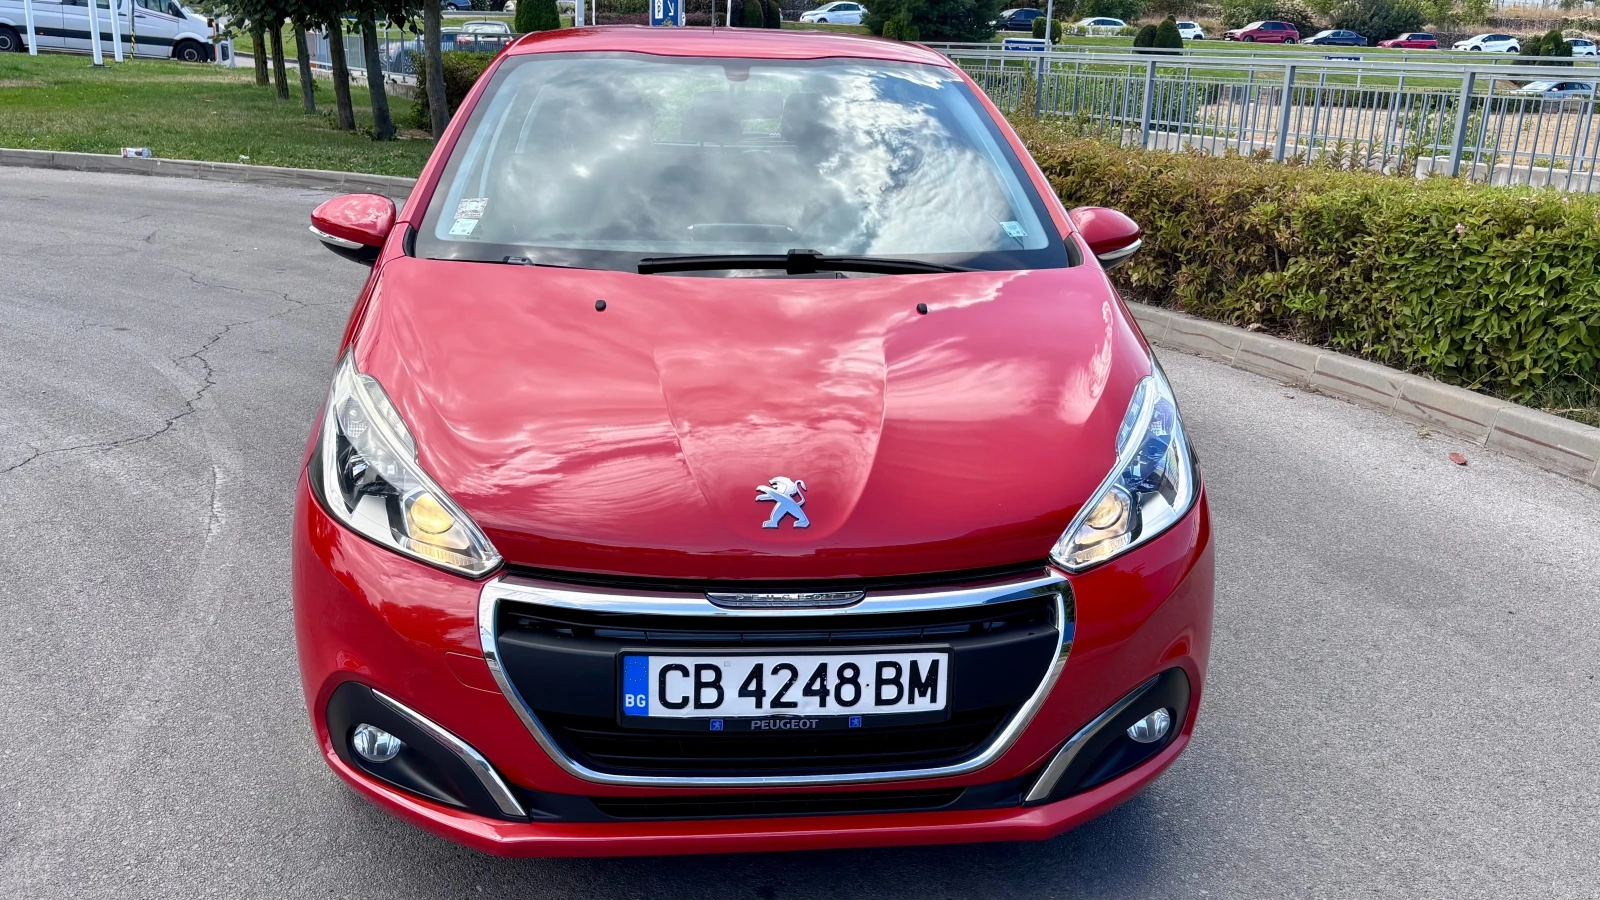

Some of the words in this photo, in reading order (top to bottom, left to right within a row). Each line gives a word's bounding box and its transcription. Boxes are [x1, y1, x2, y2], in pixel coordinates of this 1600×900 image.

[735, 592, 837, 602] PEUGEOT
[658, 663, 725, 710] CB
[738, 662, 862, 709] 4248
[874, 659, 940, 706] BM
[625, 694, 646, 708] BG
[751, 719, 819, 731] PEUGEOT
